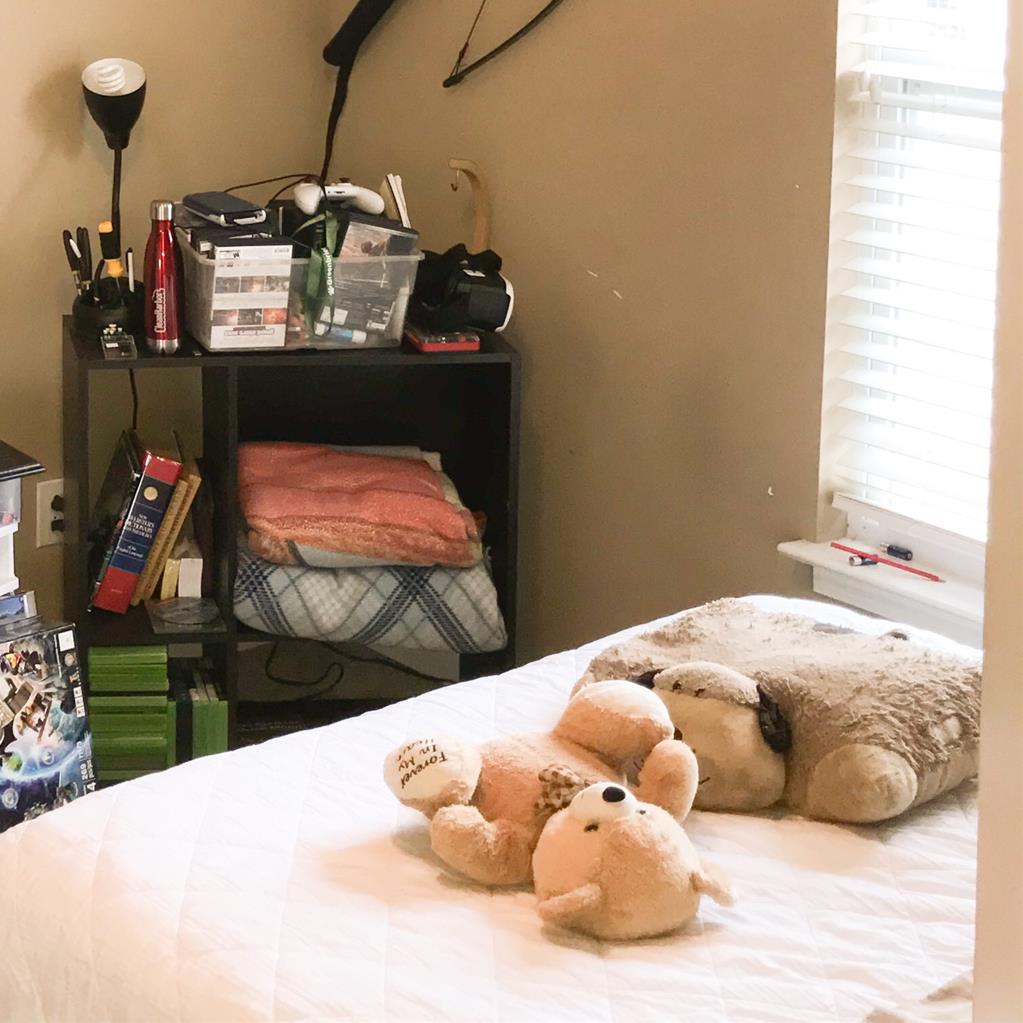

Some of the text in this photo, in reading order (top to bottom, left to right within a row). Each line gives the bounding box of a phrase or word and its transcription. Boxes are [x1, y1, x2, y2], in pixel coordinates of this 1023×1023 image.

[397, 744, 438, 772] In My
[400, 751, 448, 790] Forever
